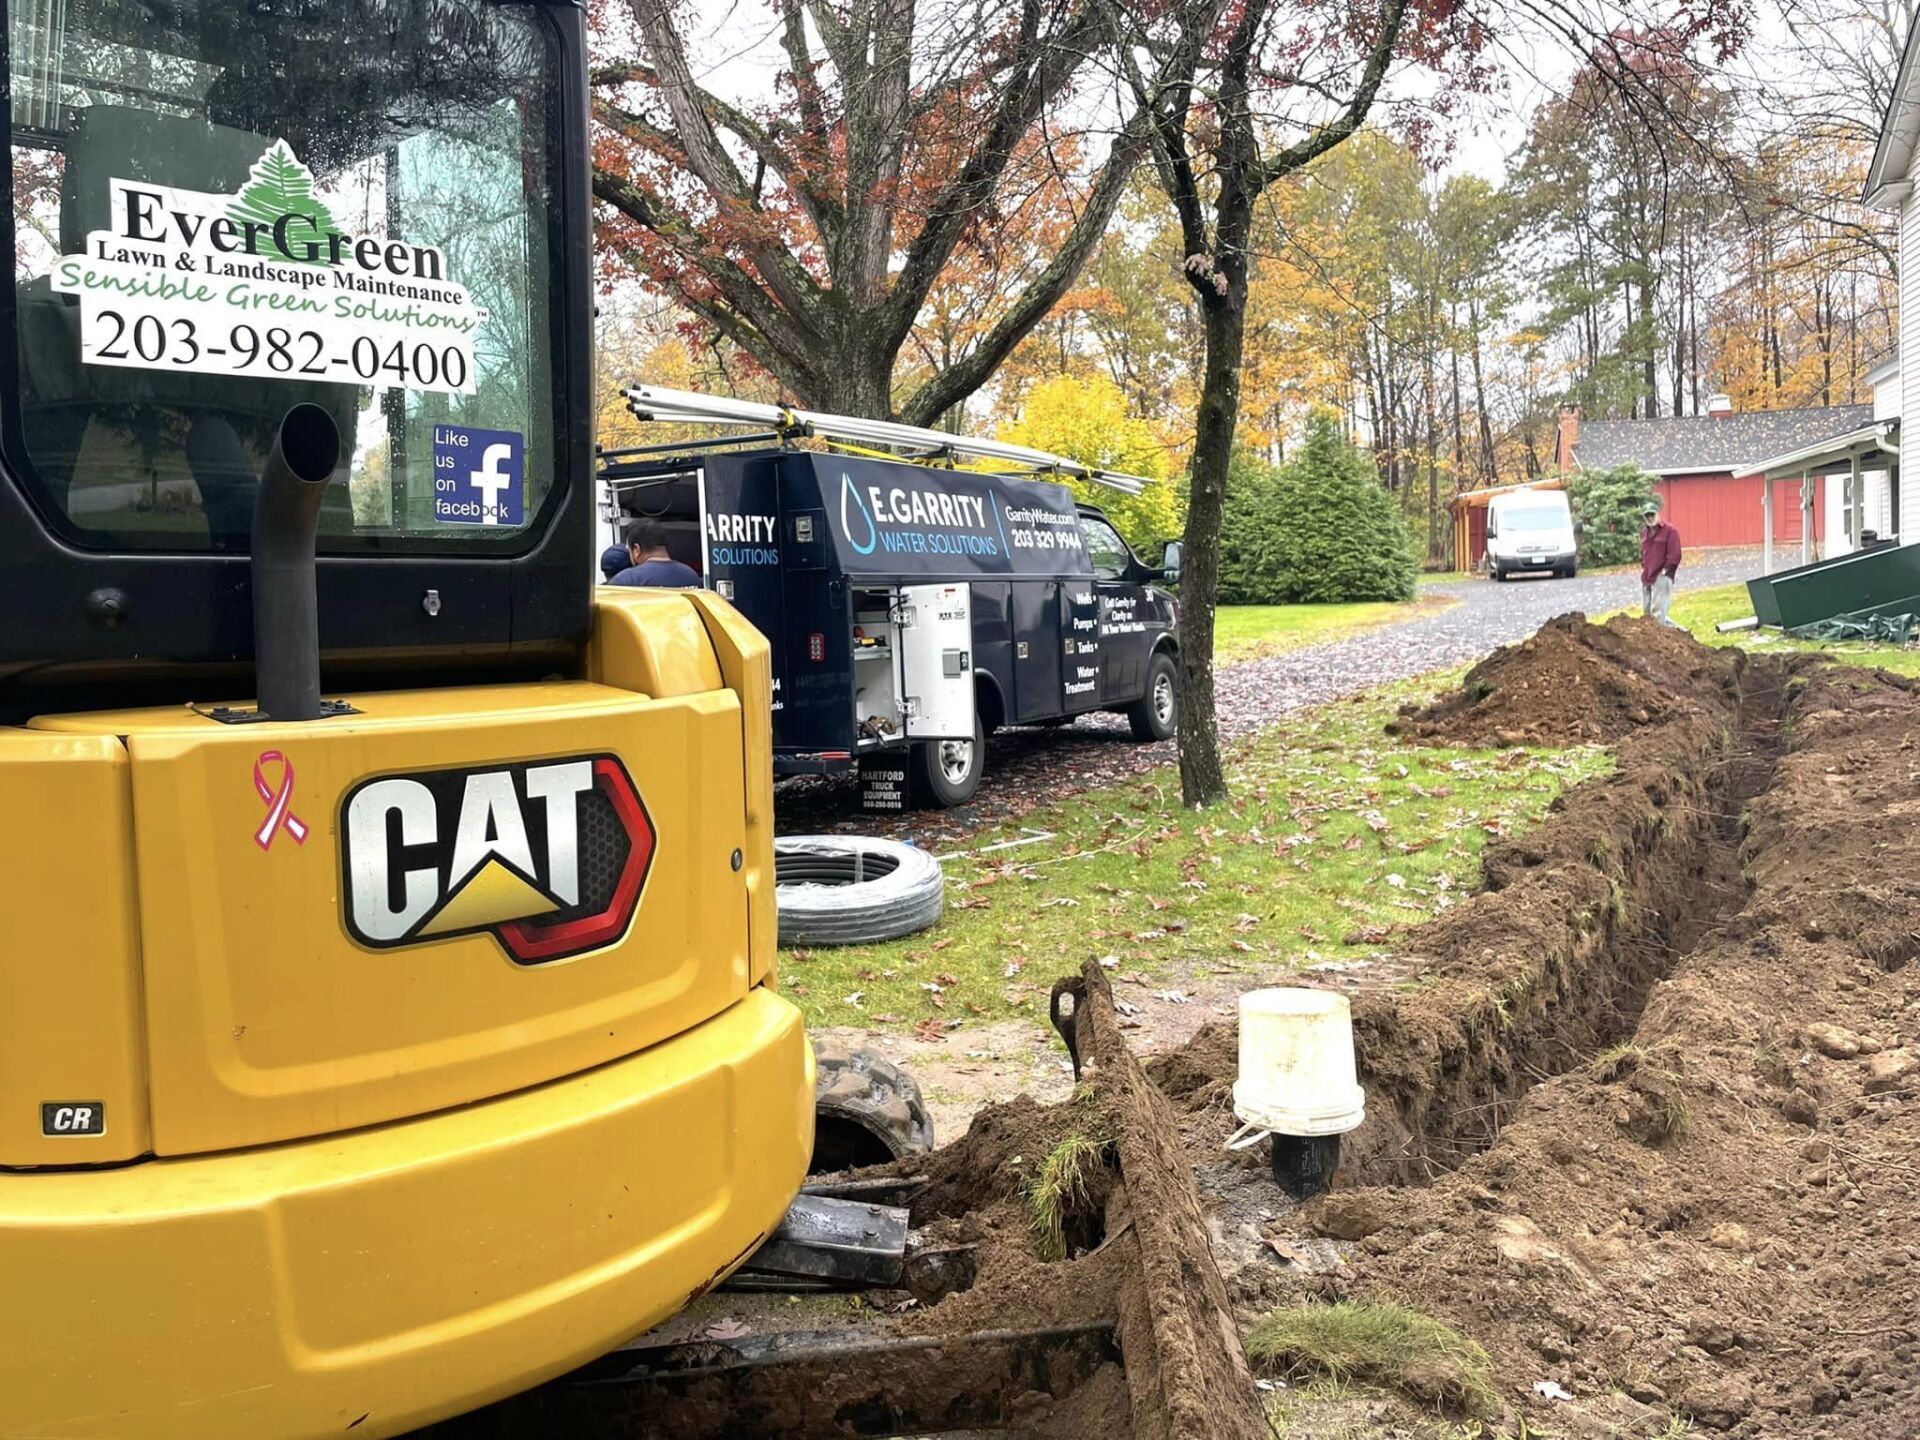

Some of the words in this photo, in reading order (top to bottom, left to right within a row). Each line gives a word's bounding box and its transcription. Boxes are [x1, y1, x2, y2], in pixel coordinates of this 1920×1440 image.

[119, 188, 443, 280] EverGreen
[96, 240, 166, 268] Lawn
[175, 252, 196, 272] &
[205, 255, 326, 289] Landscape
[333, 270, 463, 305] Maintenance
[60, 263, 217, 301] Sensible
[226, 284, 328, 314] Green
[335, 296, 475, 334] Solutions
[95, 310, 466, 387] 203-982-0400
[435, 427, 469, 447] Like
[435, 455, 455, 469] us
[435, 478, 456, 492] on
[435, 498, 509, 518] facebook
[868, 486, 985, 528] E.GARRITY
[1005, 505, 1075, 527] GarrityWater.com
[880, 531, 925, 553] WATER
[929, 532, 997, 556] SOLUTIONS
[1011, 528, 1032, 548] 203
[1036, 529, 1054, 549] 329
[1057, 531, 1082, 550] 9944
[712, 547, 779, 565] SOLUTIONS
[1075, 591, 1092, 605] Wells
[1073, 617, 1093, 631] Pumps
[1077, 641, 1094, 654] Tanks
[1076, 665, 1095, 678] Water
[1064, 680, 1095, 694] Treatment
[862, 770, 904, 781] HARTFORD
[871, 781, 894, 790] TRUCK
[863, 790, 901, 800] EQUIPMENT
[348, 760, 593, 941] CAT
[54, 1107, 92, 1131] CR
